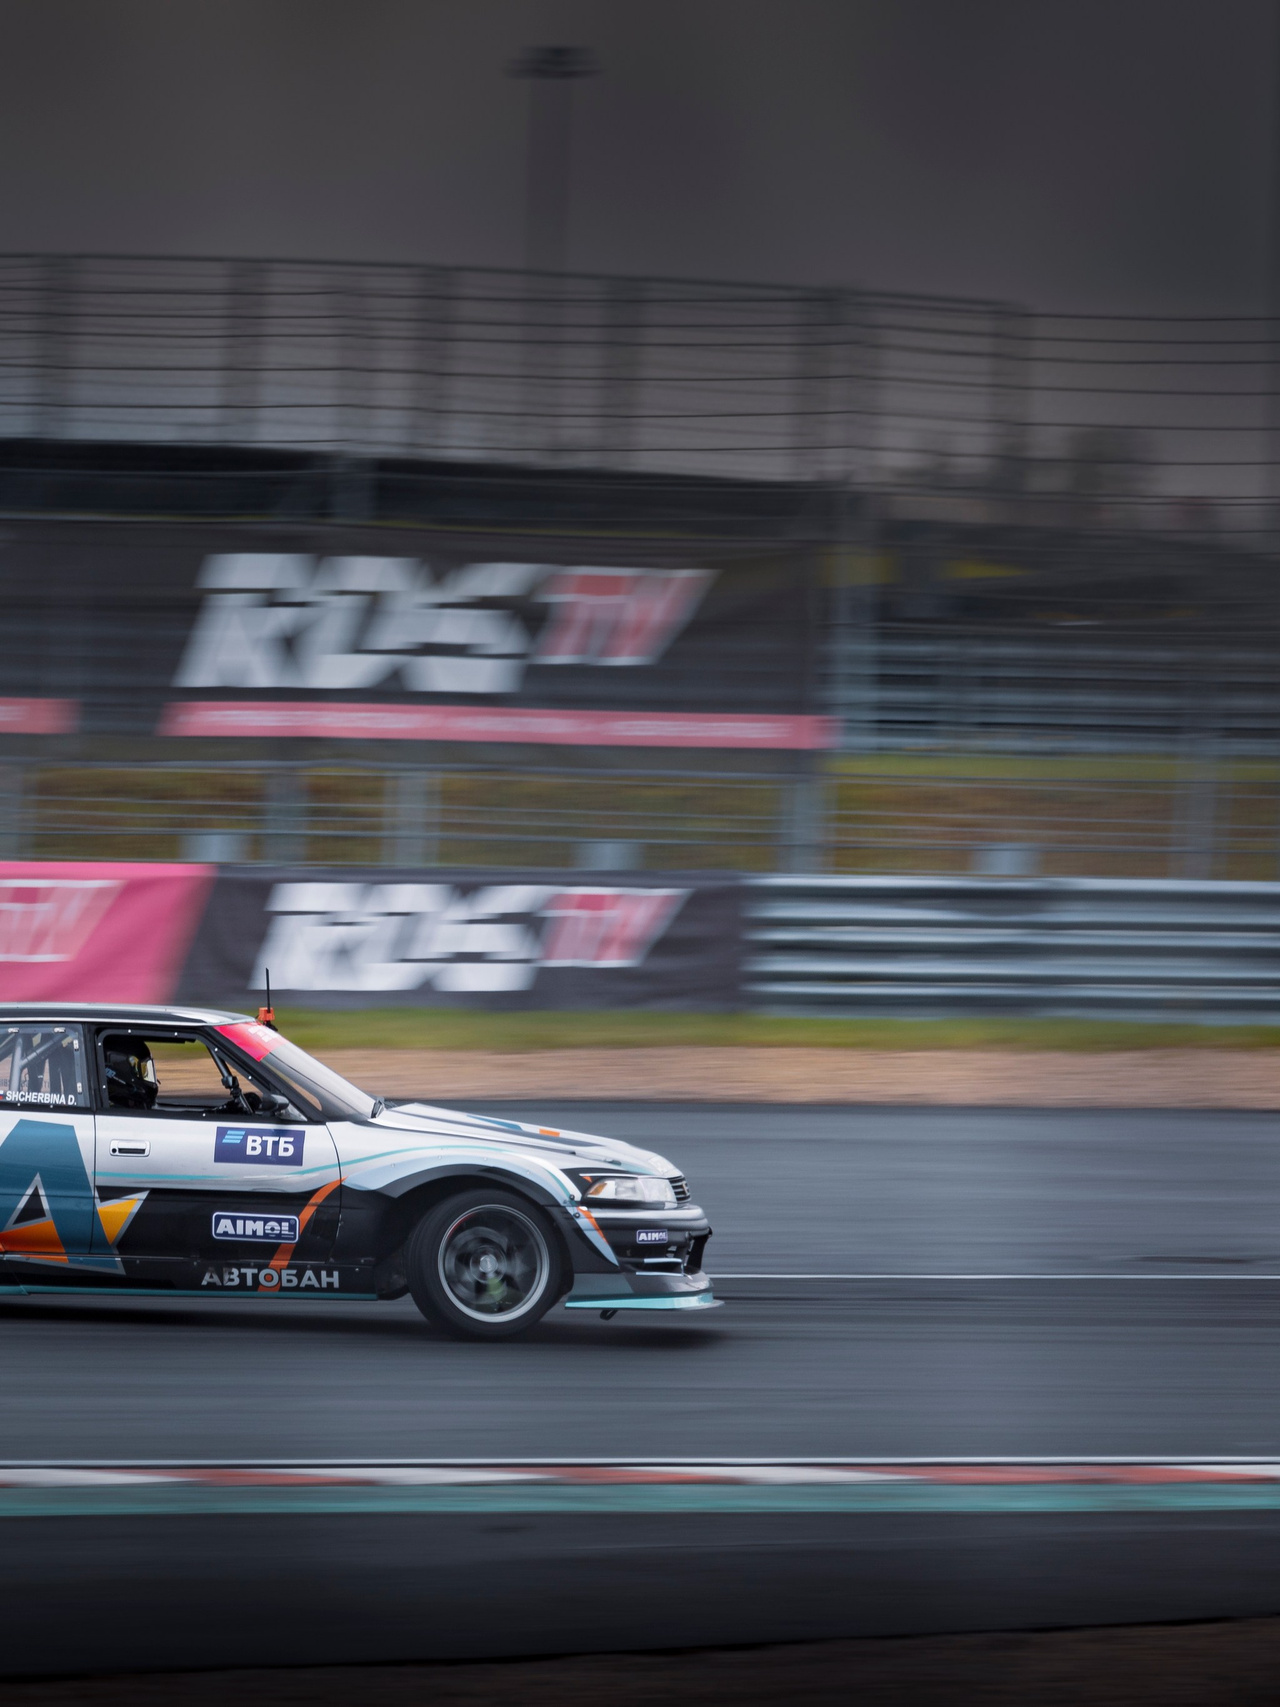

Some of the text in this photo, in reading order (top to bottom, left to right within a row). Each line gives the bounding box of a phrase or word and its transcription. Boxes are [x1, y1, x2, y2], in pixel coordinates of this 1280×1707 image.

[5, 1090, 77, 1105] SHCHERBINA D.
[246, 1135, 295, 1157] ВТБ
[216, 1218, 295, 1237] AIMOL
[200, 1266, 340, 1288] АВТОБАН
